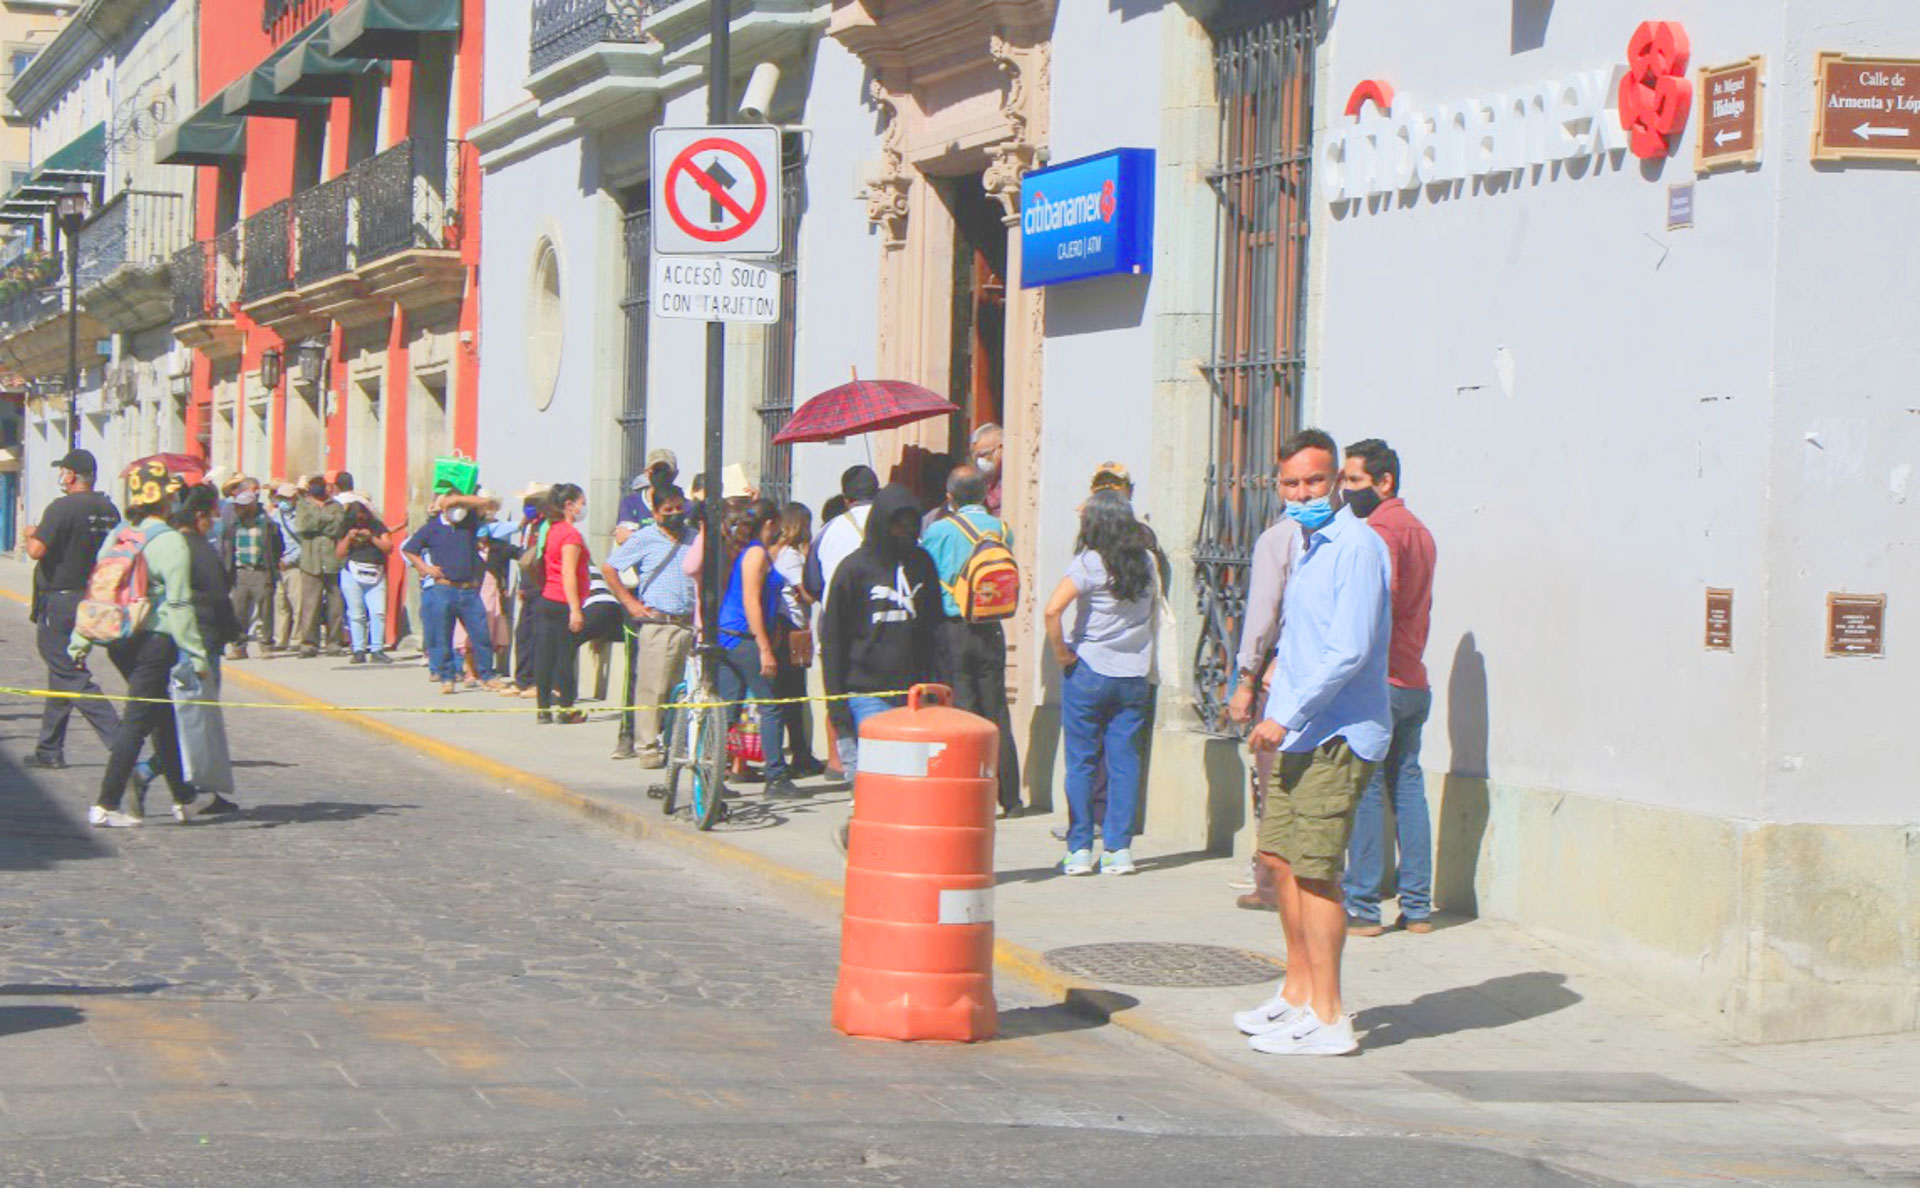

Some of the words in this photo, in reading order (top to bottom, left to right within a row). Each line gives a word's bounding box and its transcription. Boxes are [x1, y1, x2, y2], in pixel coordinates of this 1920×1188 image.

[1859, 71, 1889, 86] Calle
[1891, 73, 1906, 86] de
[1713, 98, 1745, 117] Hidalgo
[1828, 93, 1883, 109] Armenta
[1885, 98, 1895, 112] y
[1025, 191, 1102, 235] citibanamex
[1057, 240, 1083, 260] CAJERO
[1087, 236, 1102, 254] ATM
[663, 265, 722, 286] ACCESO
[731, 267, 767, 288] SOLO
[662, 293, 691, 312] CON
[703, 294, 774, 316] TARJETON
